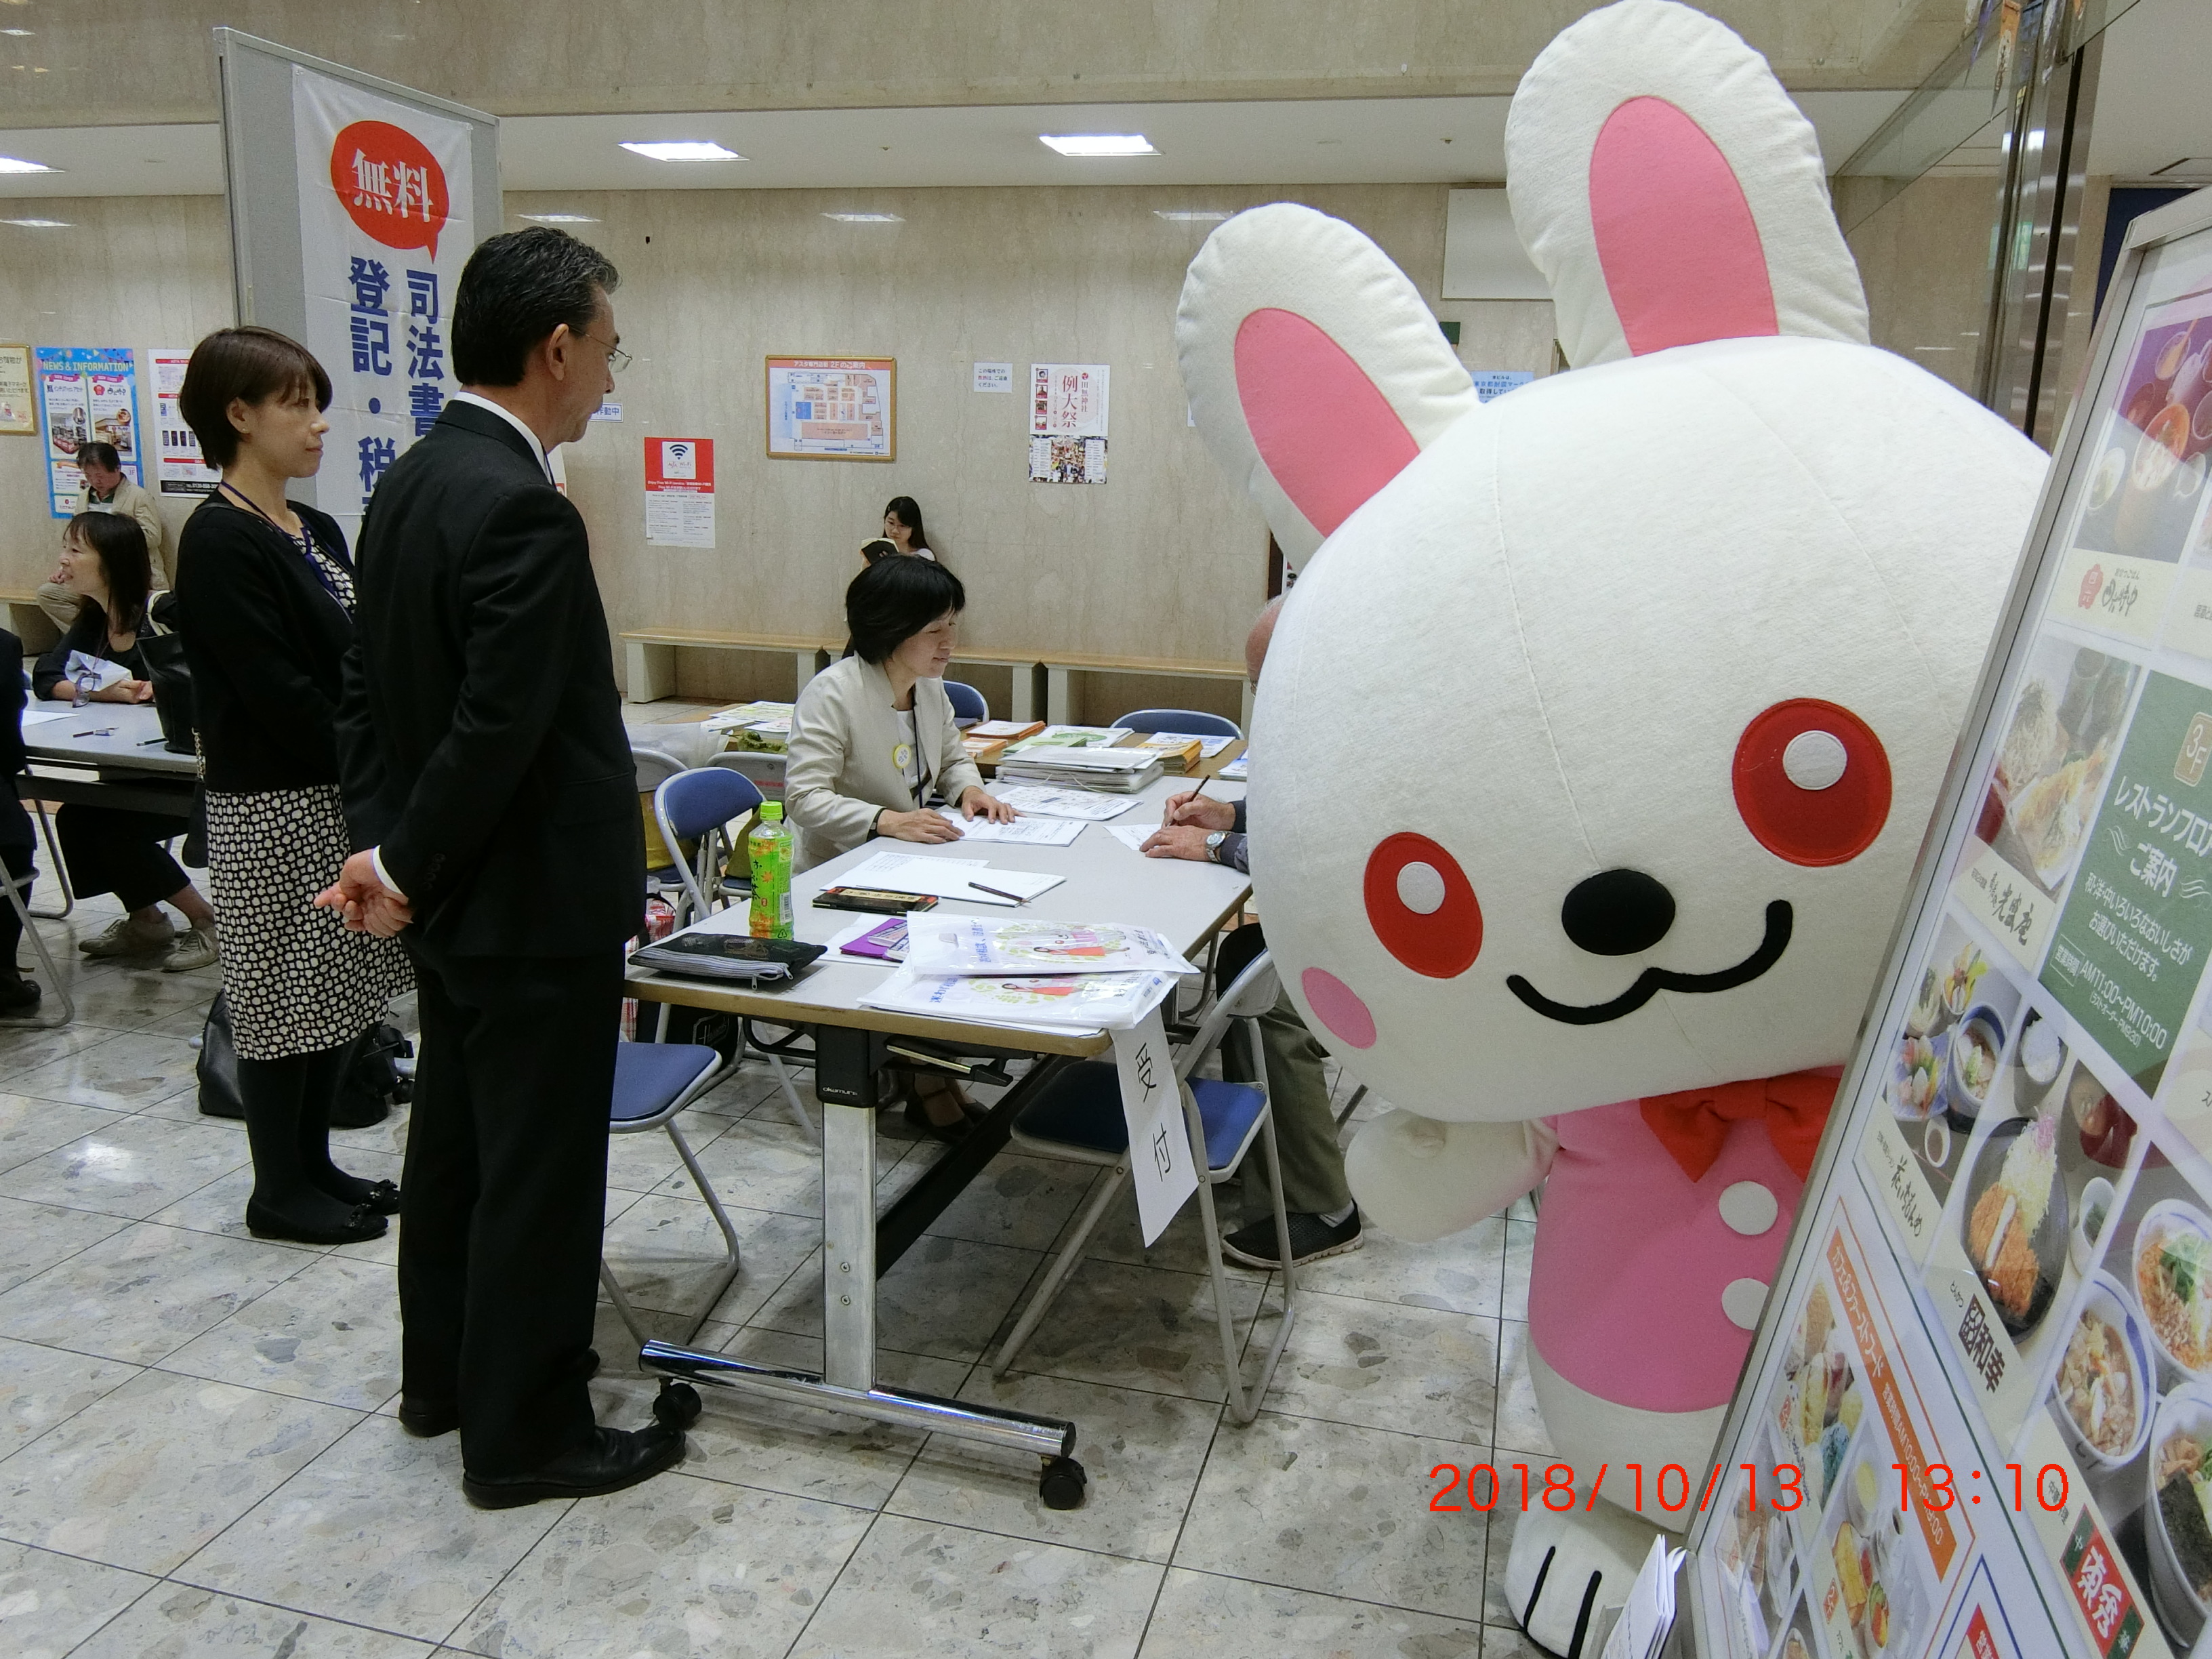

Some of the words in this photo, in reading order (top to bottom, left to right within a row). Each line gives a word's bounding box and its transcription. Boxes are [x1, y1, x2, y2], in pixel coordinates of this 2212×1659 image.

[352, 148, 434, 222] 無料
[43, 361, 63, 371] NEWS
[65, 362, 71, 371] &
[73, 361, 129, 372] INFORMATION
[348, 255, 396, 513] 登記・税
[1062, 375, 1078, 428] 例大祭
[2186, 723, 2208, 775] 3F
[2129, 842, 2179, 898] ご案内
[2054, 943, 2082, 977] 営業時間
[2088, 909, 2160, 983] お選びいただけます。
[822, 1086, 858, 1097] okamura
[1135, 1042, 1172, 1183] 受付
[1891, 1154, 1923, 1237] 花いちもんめ
[1950, 1279, 1964, 1309] とんかつ
[1973, 1322, 2006, 1394] 和幸
